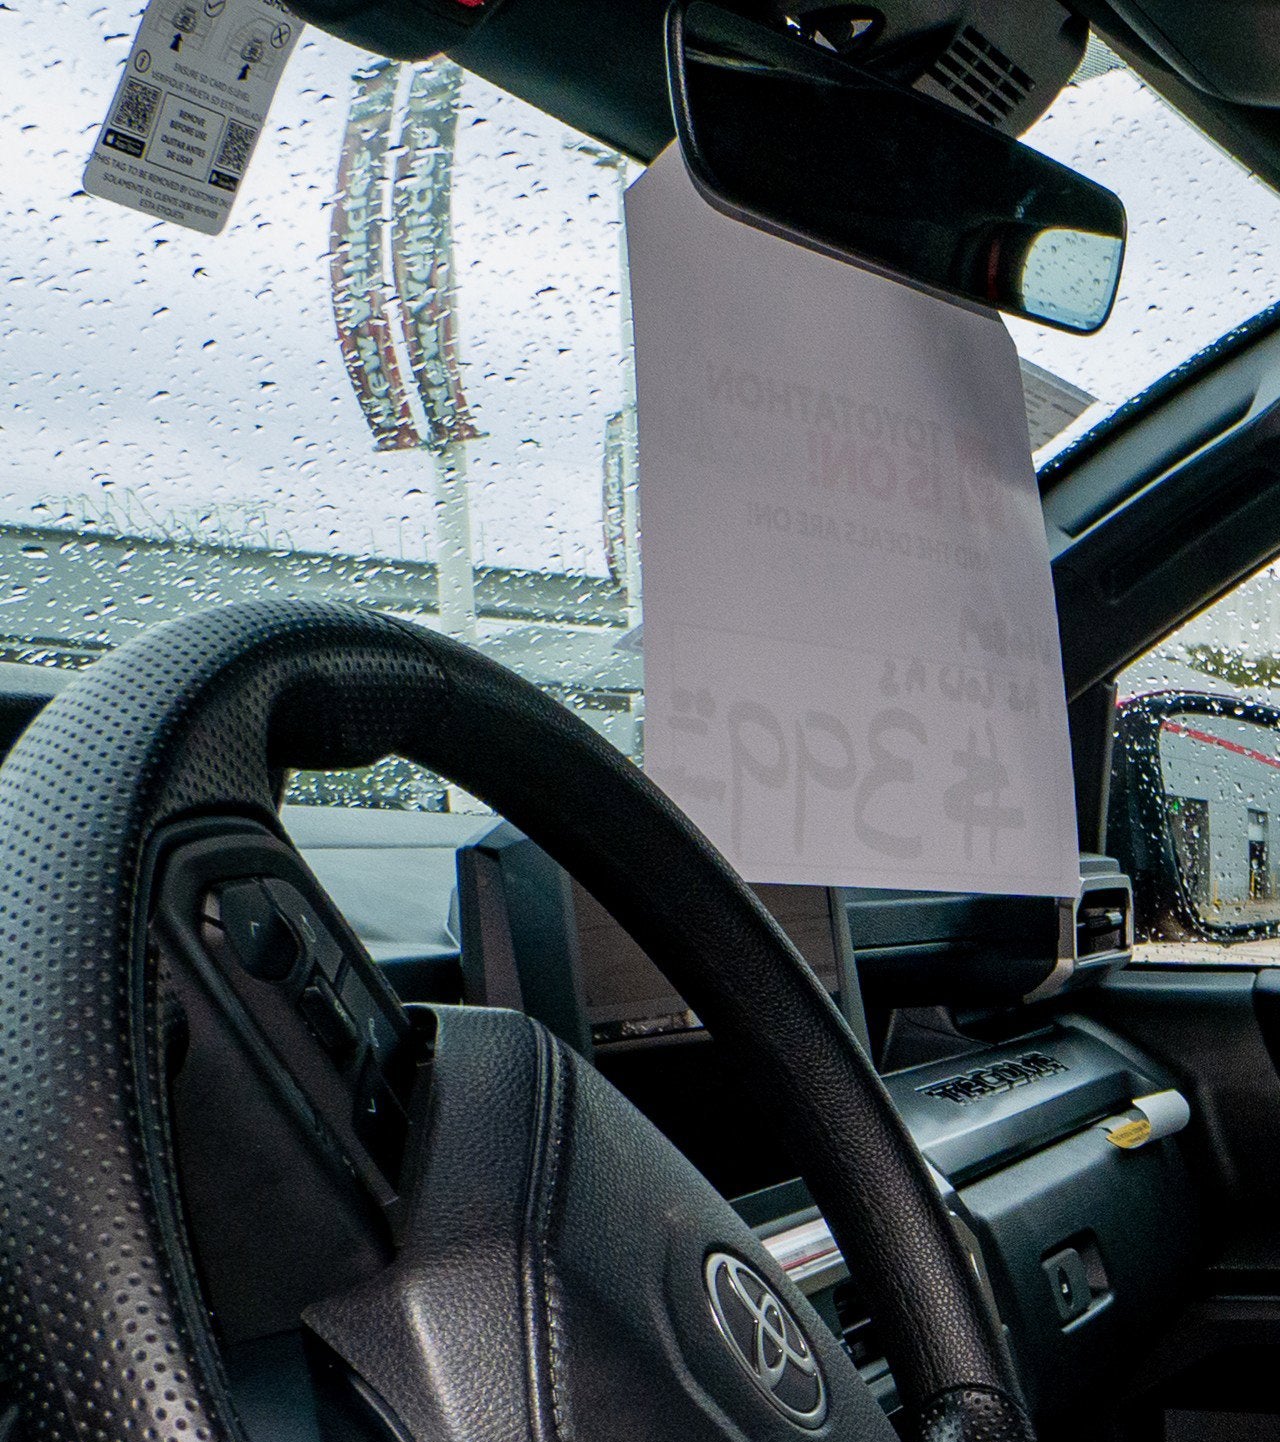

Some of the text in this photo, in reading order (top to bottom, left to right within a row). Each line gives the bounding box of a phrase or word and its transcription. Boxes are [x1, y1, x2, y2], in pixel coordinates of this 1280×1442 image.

[343, 149, 372, 326] Vehicles
[405, 126, 438, 312] Vehicles
[914, 1051, 1071, 1107] TACOMA
